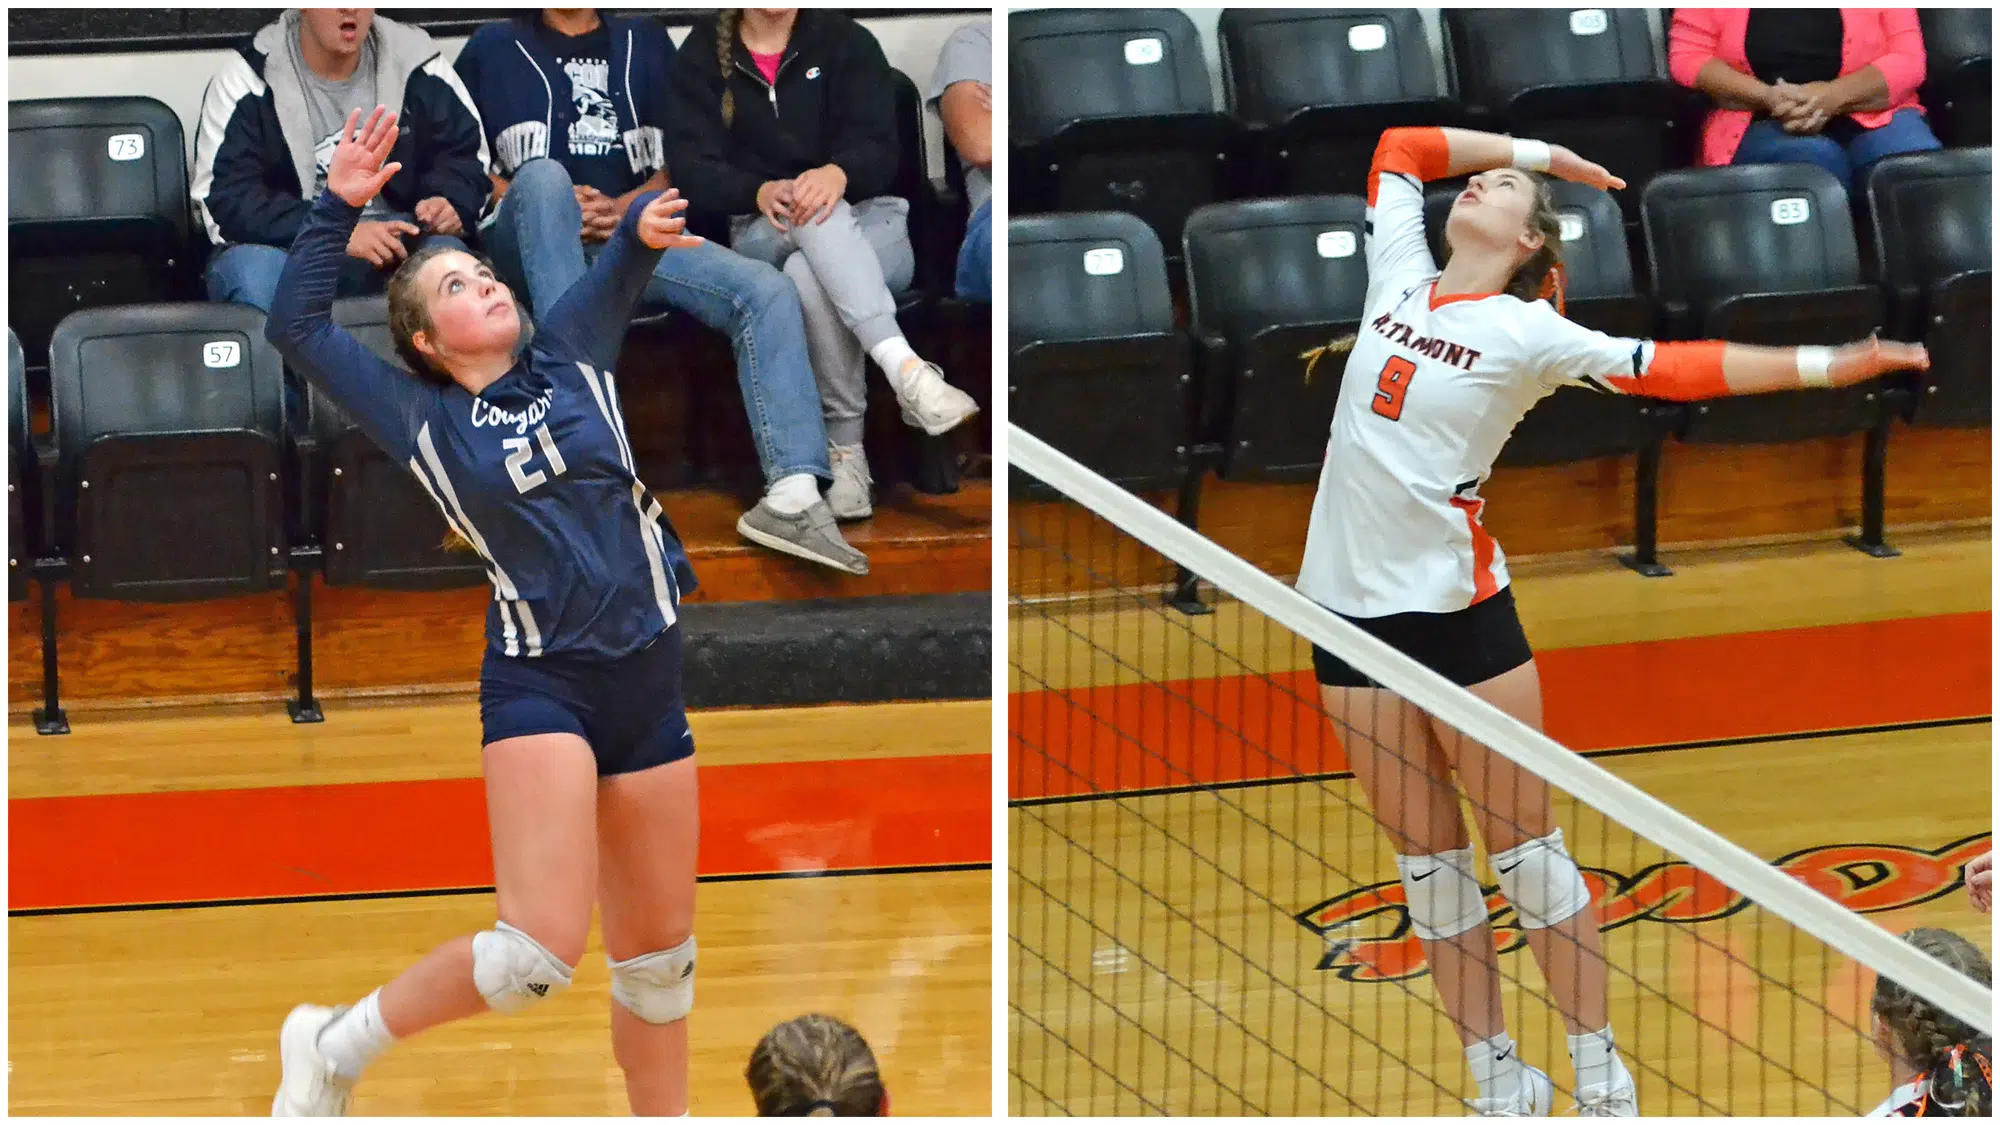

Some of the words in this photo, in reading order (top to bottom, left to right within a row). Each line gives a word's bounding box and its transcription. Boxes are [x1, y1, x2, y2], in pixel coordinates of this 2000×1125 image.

[115, 139, 137, 155] 73
[1779, 202, 1801, 219] 83
[211, 345, 233, 363] 57
[1371, 354, 1417, 422] 9
[502, 421, 567, 494] 21
